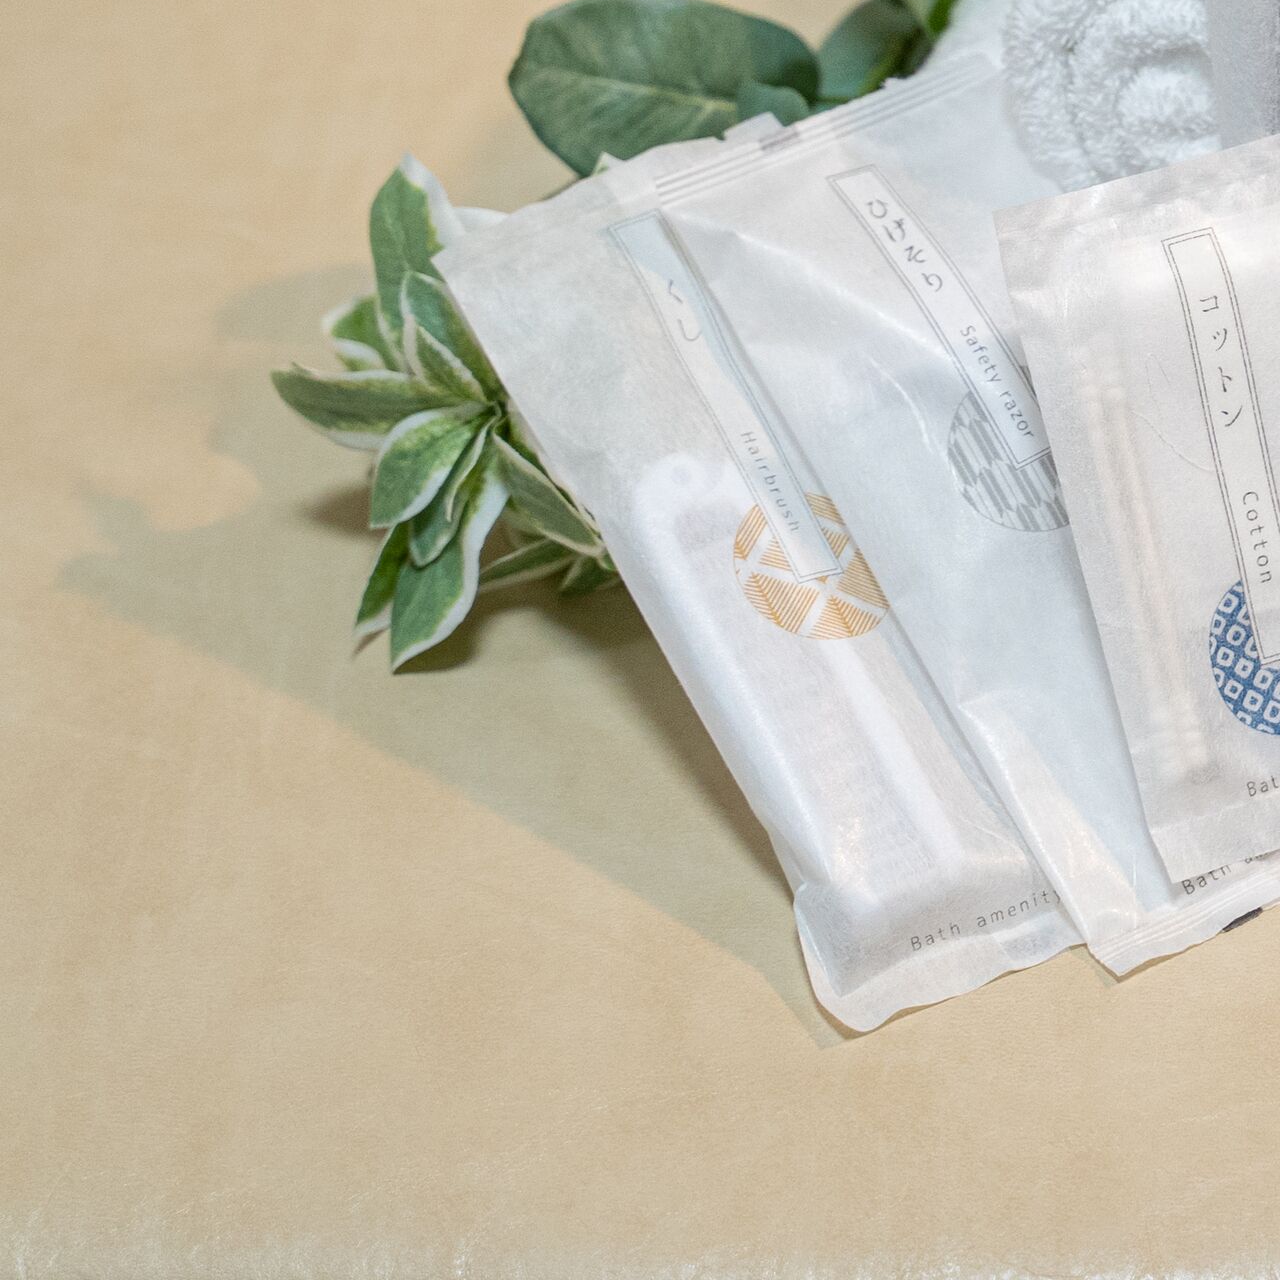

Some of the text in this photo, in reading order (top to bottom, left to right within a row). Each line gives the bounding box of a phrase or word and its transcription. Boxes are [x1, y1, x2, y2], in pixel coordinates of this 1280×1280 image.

[668, 279, 702, 342] くし
[959, 324, 1035, 439] Safety razor
[1199, 295, 1243, 428] コットン
[740, 430, 800, 533] Hairbrush
[1242, 490, 1274, 585] Cotton
[909, 922, 961, 952] Bath
